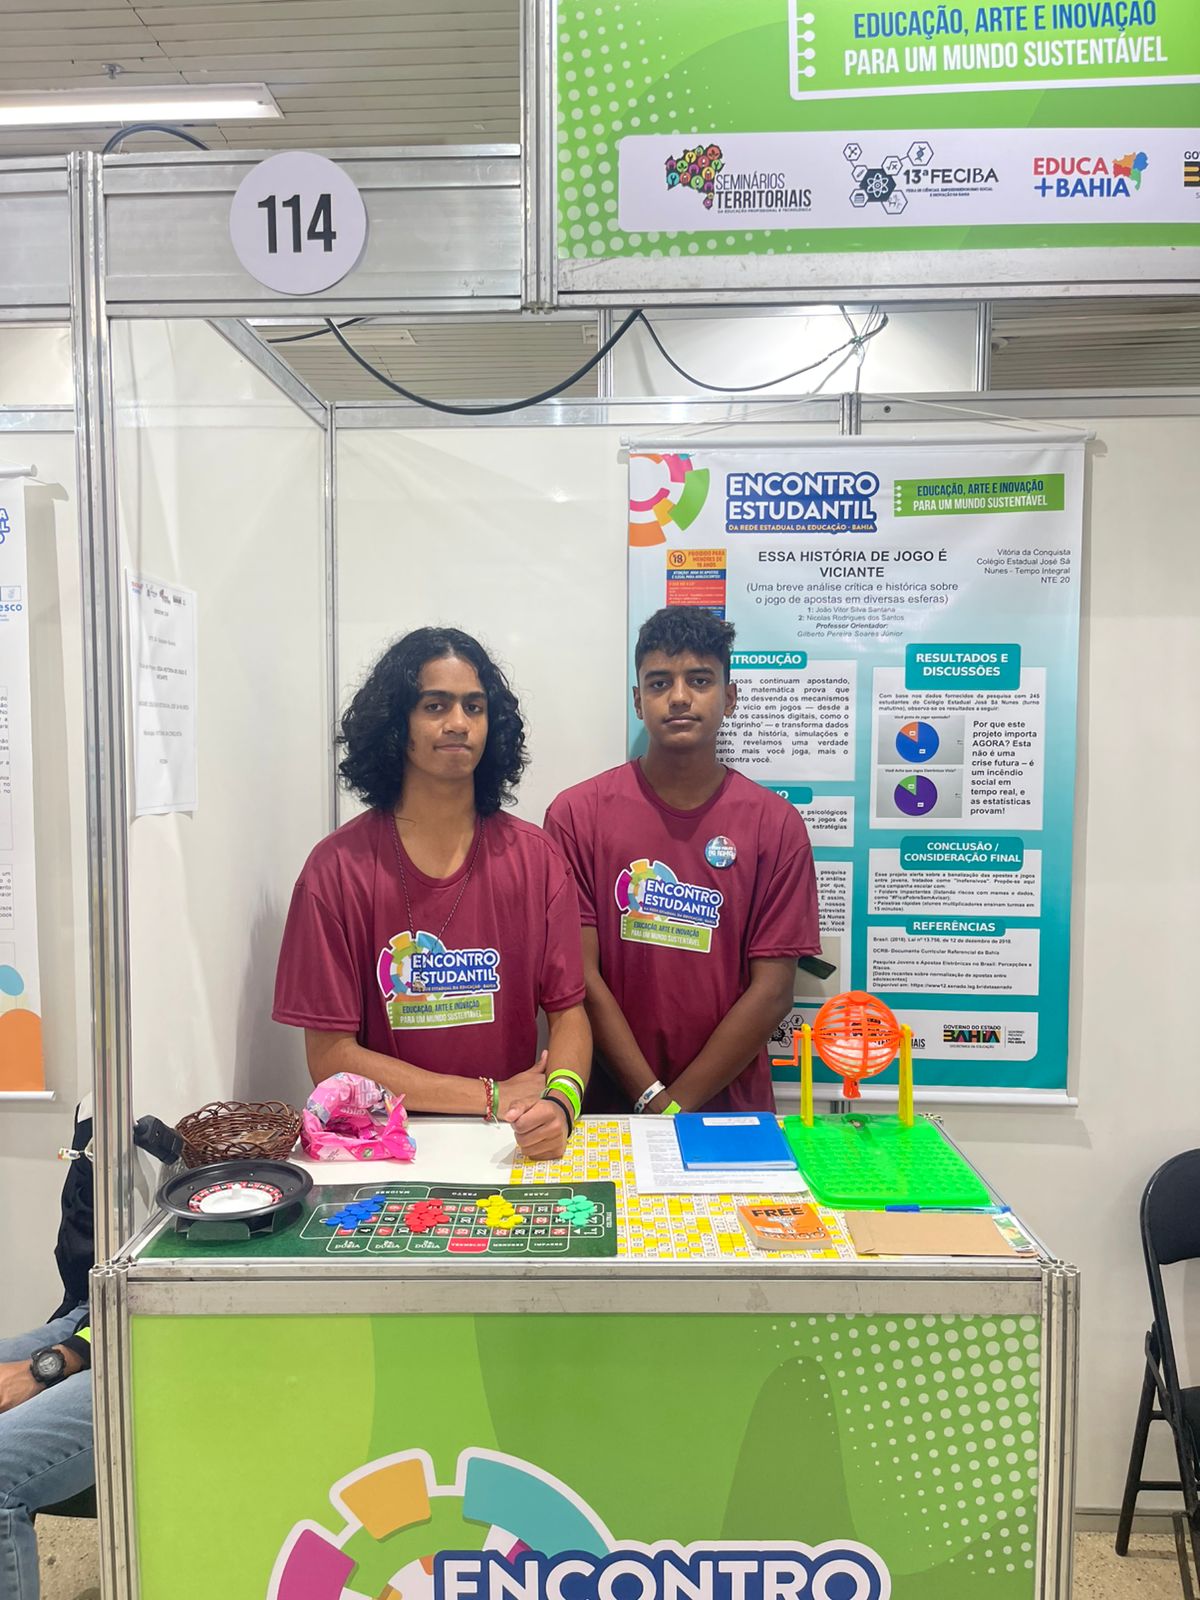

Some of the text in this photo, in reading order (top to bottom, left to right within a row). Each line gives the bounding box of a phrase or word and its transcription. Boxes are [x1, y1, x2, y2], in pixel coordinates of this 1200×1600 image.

[854, 6, 969, 40] EDUCAÇÃO,
[976, 6, 1027, 33] ARTE
[1035, 5, 1046, 30] E
[844, 32, 1169, 76] PARA UM MUNDO SUSTENTÁVEL
[1033, 157, 1109, 176] EDUCA
[716, 170, 785, 190] SEMINÁRIOS
[930, 167, 999, 184] FECIBA
[1034, 177, 1131, 198] +BAHIA
[716, 188, 812, 210] TERRITORIAIS
[257, 193, 336, 254] 114
[729, 474, 877, 497] ENCONTRO
[917, 479, 1044, 498] EDUCAÇÃO, ARTE E INOVAÇÃO
[913, 493, 1048, 511] PARA UM MUNDO SUSTENTÁVEL
[729, 499, 874, 521] ESTUDANTIL
[758, 548, 947, 562] ESSA HISTÓRIA DE JOGO É
[997, 548, 1020, 556] Vitória
[1032, 548, 1071, 557] Conquista
[976, 558, 1071, 567] Colégio Estadual José Sá
[819, 567, 885, 578] VICIANTE
[1015, 567, 1040, 576] Tempo
[1042, 567, 1070, 576] Integral
[746, 582, 773, 593] (Uma
[776, 582, 804, 592] breve
[807, 582, 842, 592] análise
[844, 582, 874, 592] crítica
[886, 582, 927, 592] histórica
[930, 582, 958, 592] sobre
[764, 594, 786, 608] jogo
[788, 595, 801, 605] de
[803, 596, 842, 607] apostas
[863, 595, 905, 605] diversas
[908, 595, 949, 606] esferas)
[730, 653, 802, 666] TRODUÇÃO
[916, 653, 1008, 663] RESULTADOS E
[923, 665, 1001, 677] DISCUSSÕES
[807, 677, 850, 685] apostando,
[835, 687, 850, 695] que
[990, 722, 1005, 730] que
[973, 730, 1037, 740] projeto importa
[972, 740, 1031, 748] AGORA? Esta
[971, 789, 998, 798] tempo
[1000, 788, 1018, 796] real,
[982, 798, 1031, 806] estatísticas
[970, 808, 1005, 816] provam!
[927, 841, 999, 852] CONCLUSÃO /
[904, 852, 1022, 864] CONSIDERAÇÃO FINAL
[647, 880, 720, 904] ENCONTRO
[645, 894, 717, 918] ESTUDANTIL
[913, 920, 996, 932] REFERÊNCIAS
[413, 951, 497, 968] ENCONTRO
[412, 969, 497, 984] ESTUDANTIL
[752, 1206, 805, 1217] FREE
[444, 1558, 872, 1600] ENCONTRO
